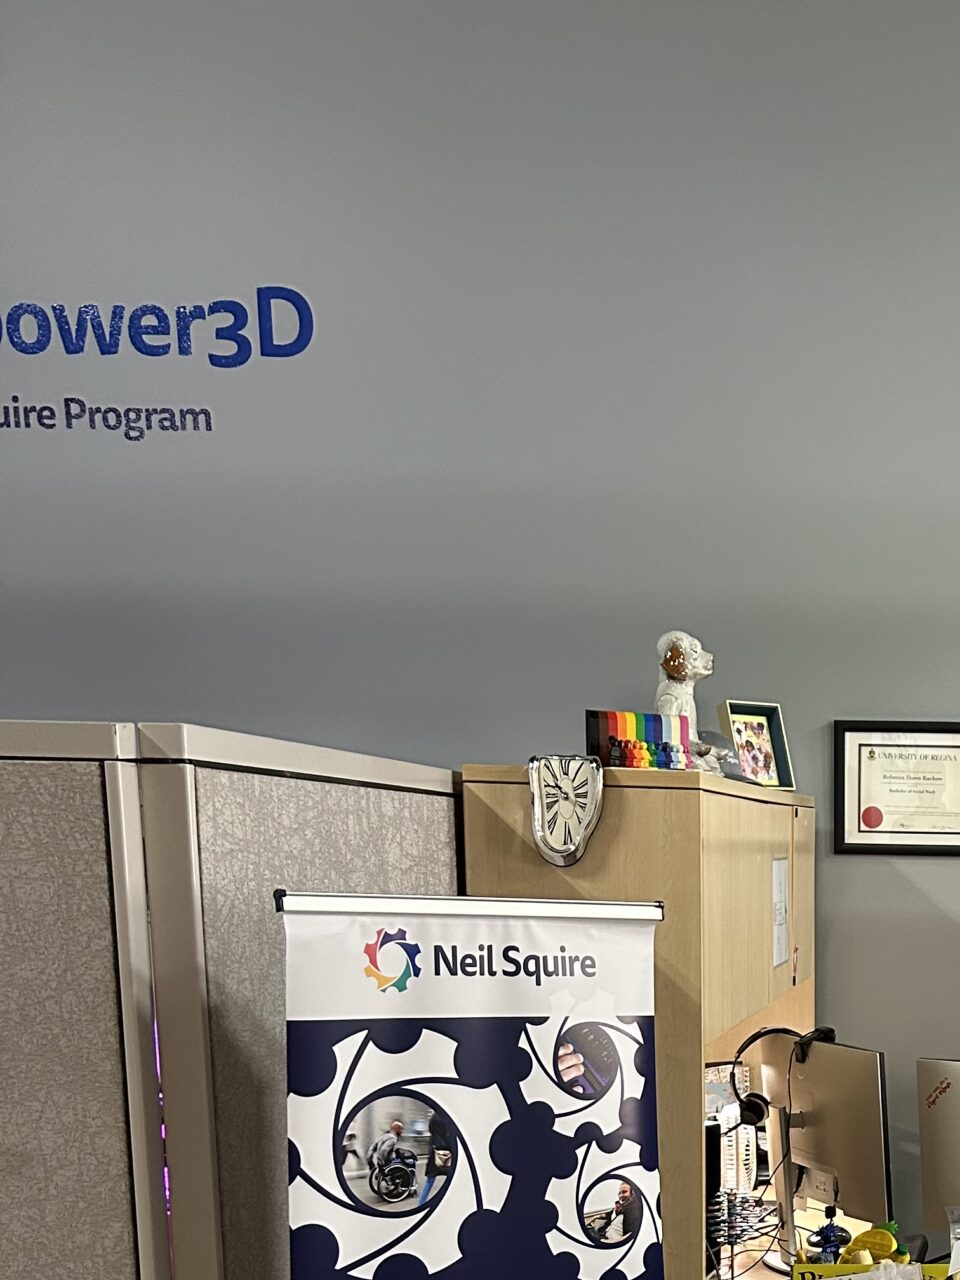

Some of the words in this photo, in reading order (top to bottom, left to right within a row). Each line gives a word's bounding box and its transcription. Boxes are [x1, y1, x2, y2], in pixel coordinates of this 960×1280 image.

[0, 285, 314, 368] ower3D
[63, 397, 212, 441] Program
[877, 752, 918, 761] UNIVERSITY
[919, 753, 929, 761] OF
[931, 753, 958, 762] REGINA
[433, 944, 497, 977] Neil
[502, 945, 597, 986] Squire
